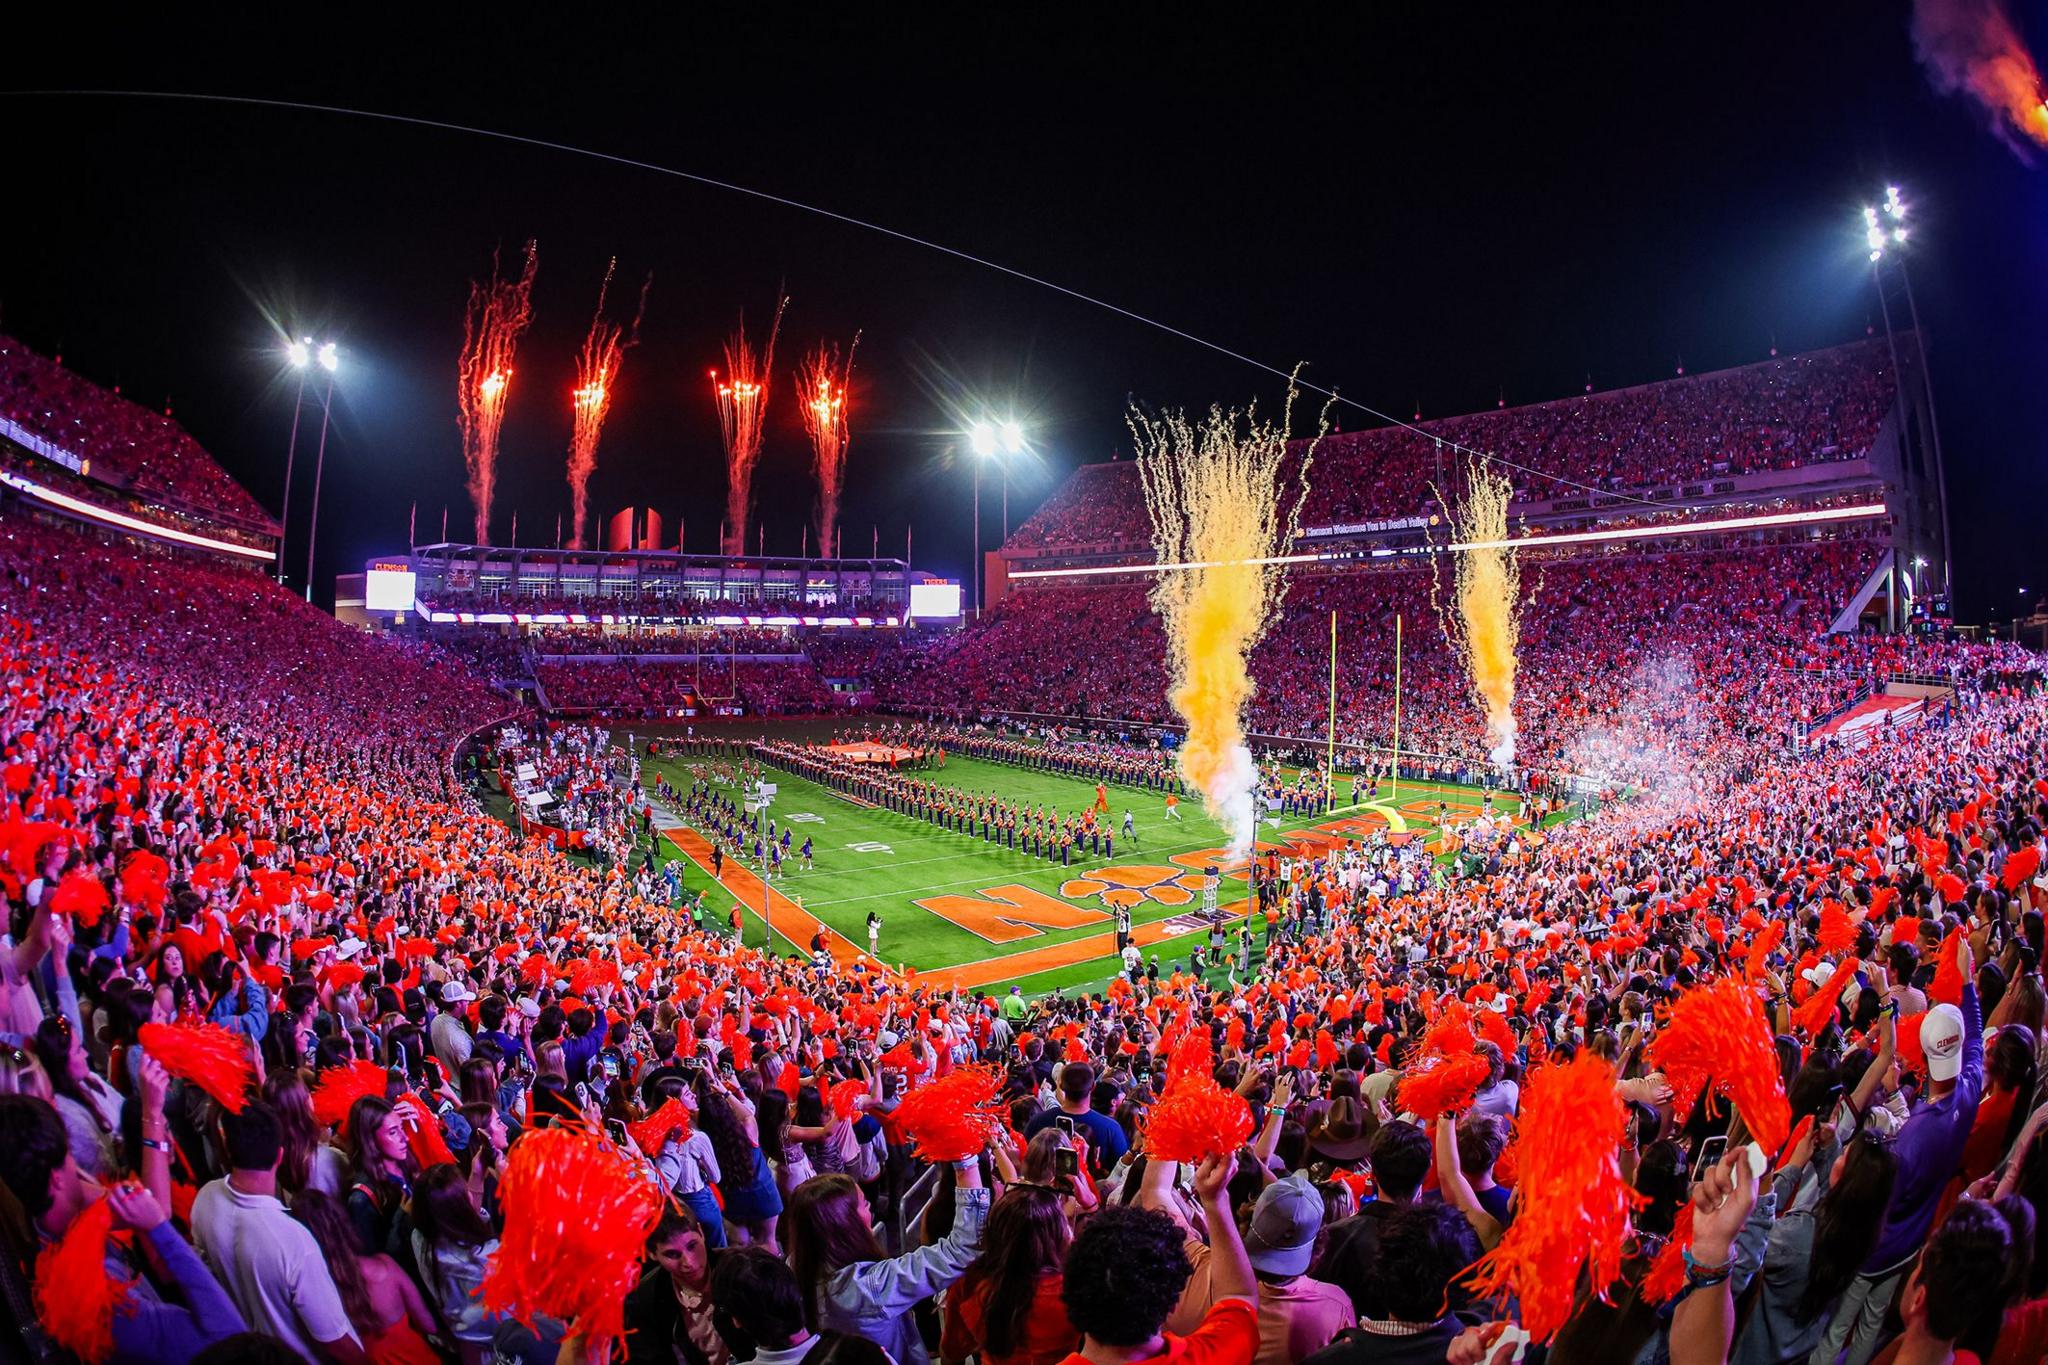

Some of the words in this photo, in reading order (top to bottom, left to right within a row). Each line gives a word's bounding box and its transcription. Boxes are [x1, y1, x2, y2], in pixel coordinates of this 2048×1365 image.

[1552, 499, 1590, 511] NATIONAL
[1683, 485, 1704, 496] 2016
[1306, 527, 1332, 537] Clemson
[1333, 524, 1366, 534] Welcomes
[1366, 521, 1379, 532] You
[1380, 521, 1387, 530] to
[1387, 518, 1408, 530] Death
[1408, 516, 1429, 527] Valley
[376, 563, 407, 571] CLEMSON
[1937, 1035, 1959, 1048] CLEMSON
